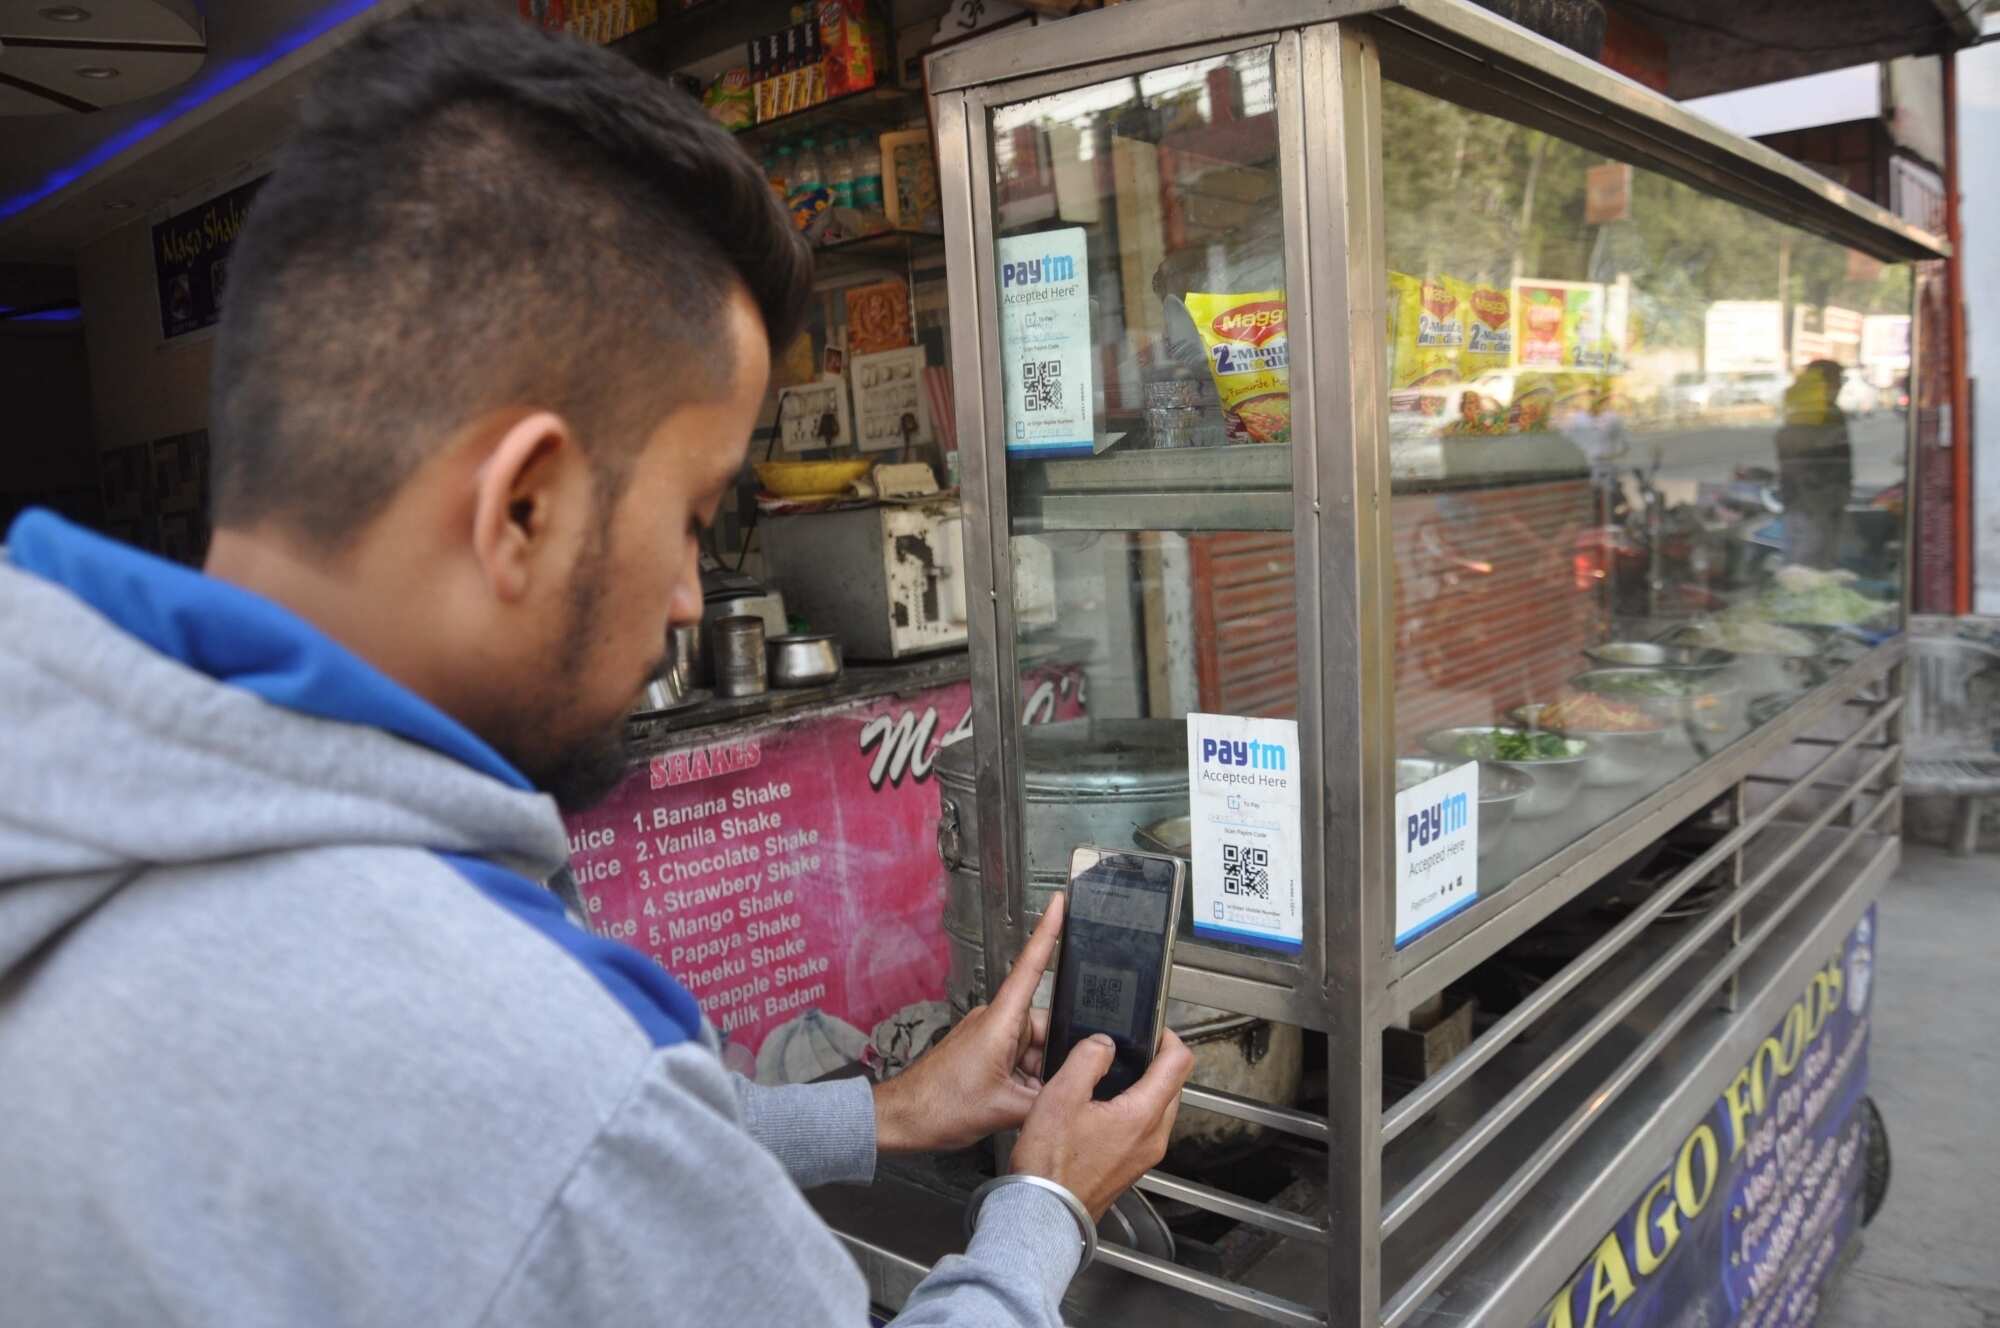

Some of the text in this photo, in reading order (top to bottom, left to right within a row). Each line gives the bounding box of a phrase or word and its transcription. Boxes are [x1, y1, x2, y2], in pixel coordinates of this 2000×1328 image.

[1004, 287, 1075, 304] Accepted Here
[1222, 308, 1283, 330] Magg
[651, 741, 761, 789] SHAKES
[1203, 769, 1287, 789] Accepted Here
[633, 781, 791, 834] 1. Banana Shake
[567, 828, 615, 854] uice
[635, 811, 782, 863] 2. Vanila Shake
[638, 829, 819, 890] 3. Chocolate Shake
[1408, 840, 1466, 878] Accepted Here
[574, 858, 622, 885] uice
[643, 854, 821, 917] 4. Strawbery Shake
[600, 919, 638, 939] ice
[649, 889, 794, 946] 5. Mango Shake
[672, 932, 742, 968] Papaya
[747, 913, 801, 942] Shake
[751, 938, 806, 968] Shake
[700, 957, 828, 1012] neapple Shake
[721, 983, 826, 1033] Milk Badam
